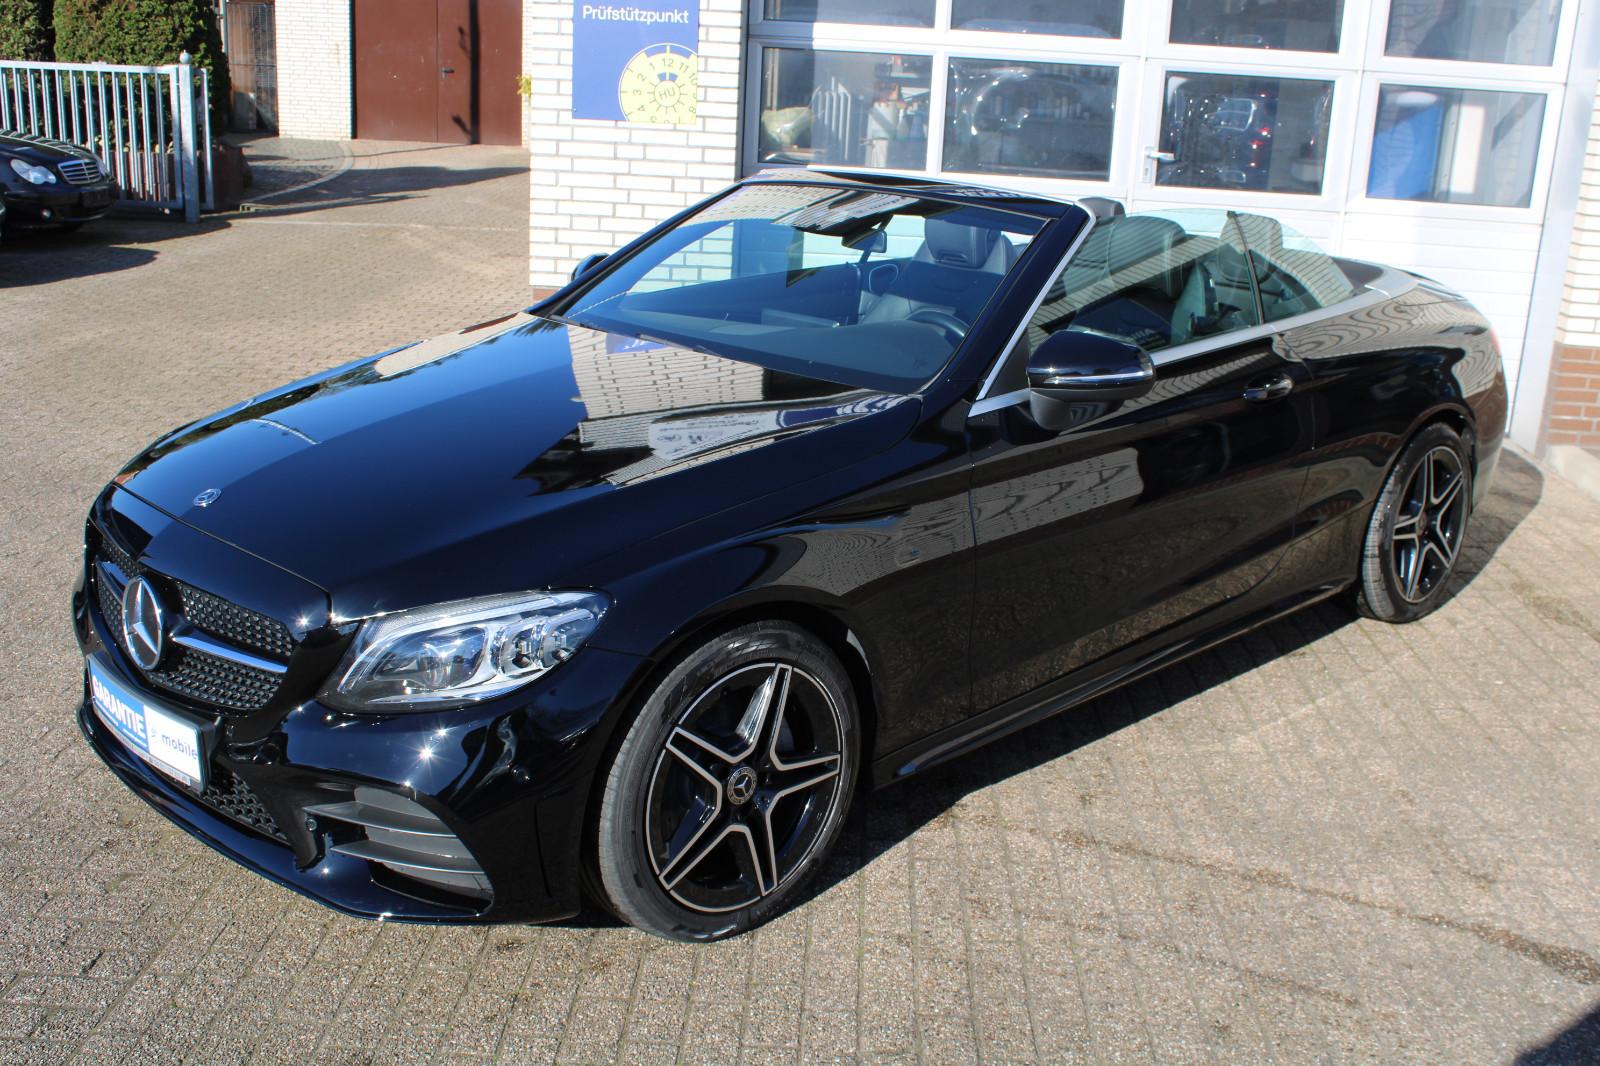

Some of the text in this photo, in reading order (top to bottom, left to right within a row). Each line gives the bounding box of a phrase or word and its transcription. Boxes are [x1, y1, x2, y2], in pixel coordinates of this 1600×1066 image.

[582, 5, 689, 25] Prüfstützpunkt
[662, 58, 674, 68] 12
[679, 62, 689, 73] 11
[637, 73, 647, 82] 2
[658, 87, 676, 100] HU
[637, 104, 646, 112] 4
[92, 674, 146, 739] GARANTIE
[161, 734, 199, 760] mobile
